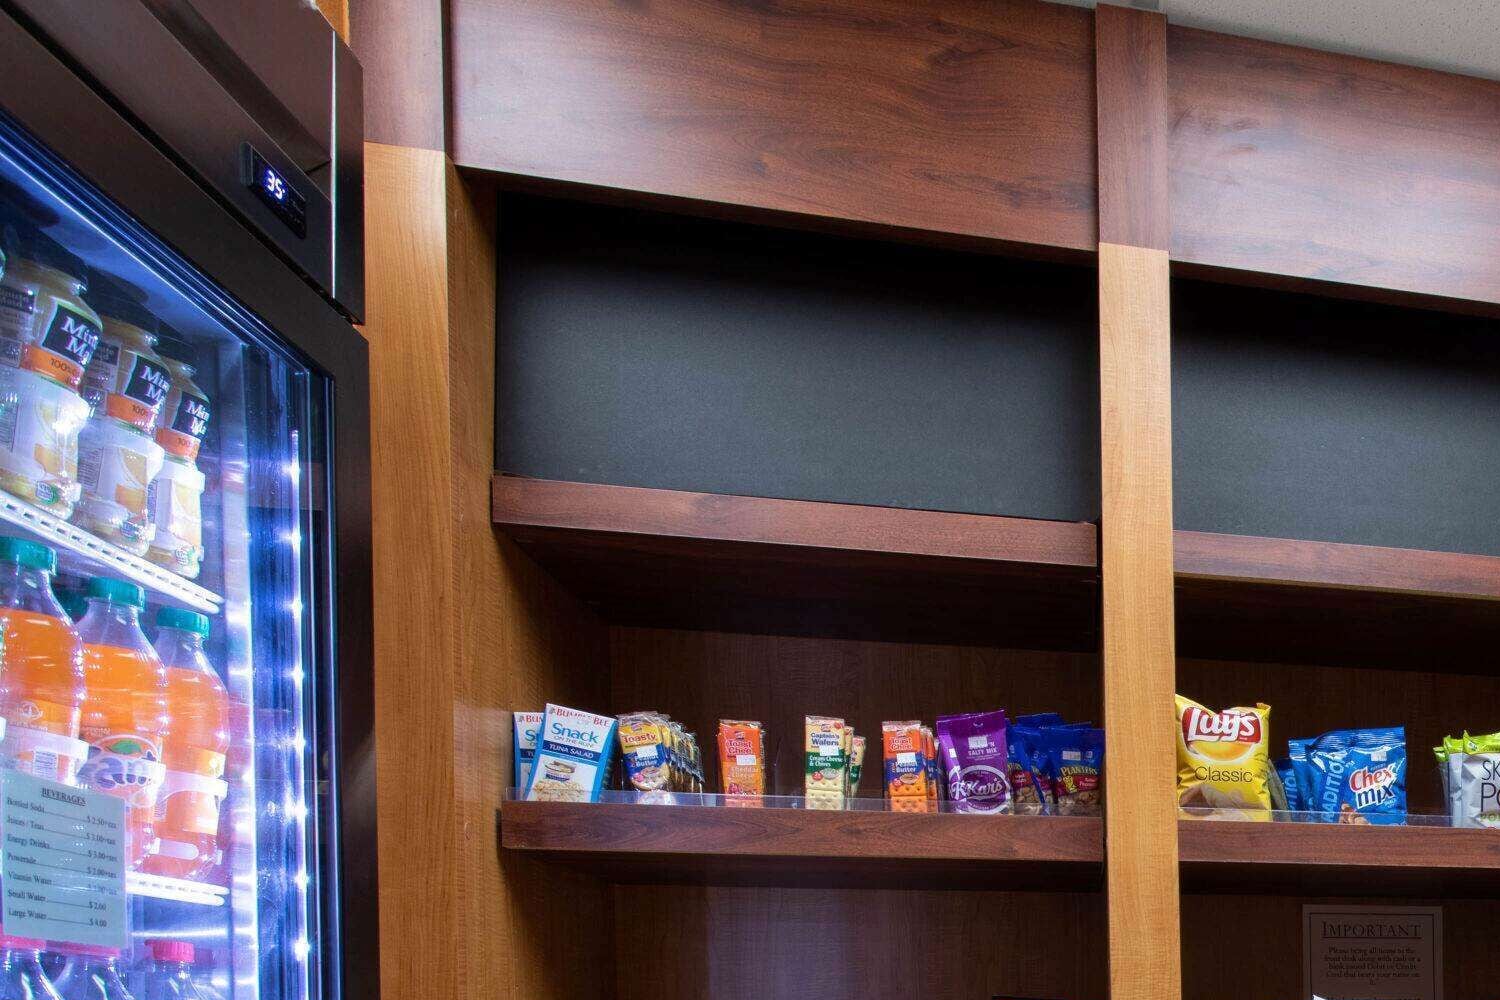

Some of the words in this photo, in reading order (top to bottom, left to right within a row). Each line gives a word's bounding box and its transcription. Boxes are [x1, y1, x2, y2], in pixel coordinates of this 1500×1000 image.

[265, 171, 285, 200] 35
[551, 722, 599, 744] Snack
[1187, 707, 1259, 742] Lay's
[622, 733, 656, 744] Toasty
[549, 743, 568, 754] TUNA
[570, 748, 593, 759] SALAD
[1194, 766, 1253, 784] Classic
[1349, 764, 1396, 793] Chex
[41, 787, 87, 806] BEVERAGES
[7, 834, 28, 847] Energy
[1322, 922, 1422, 937] IMPORTANT
